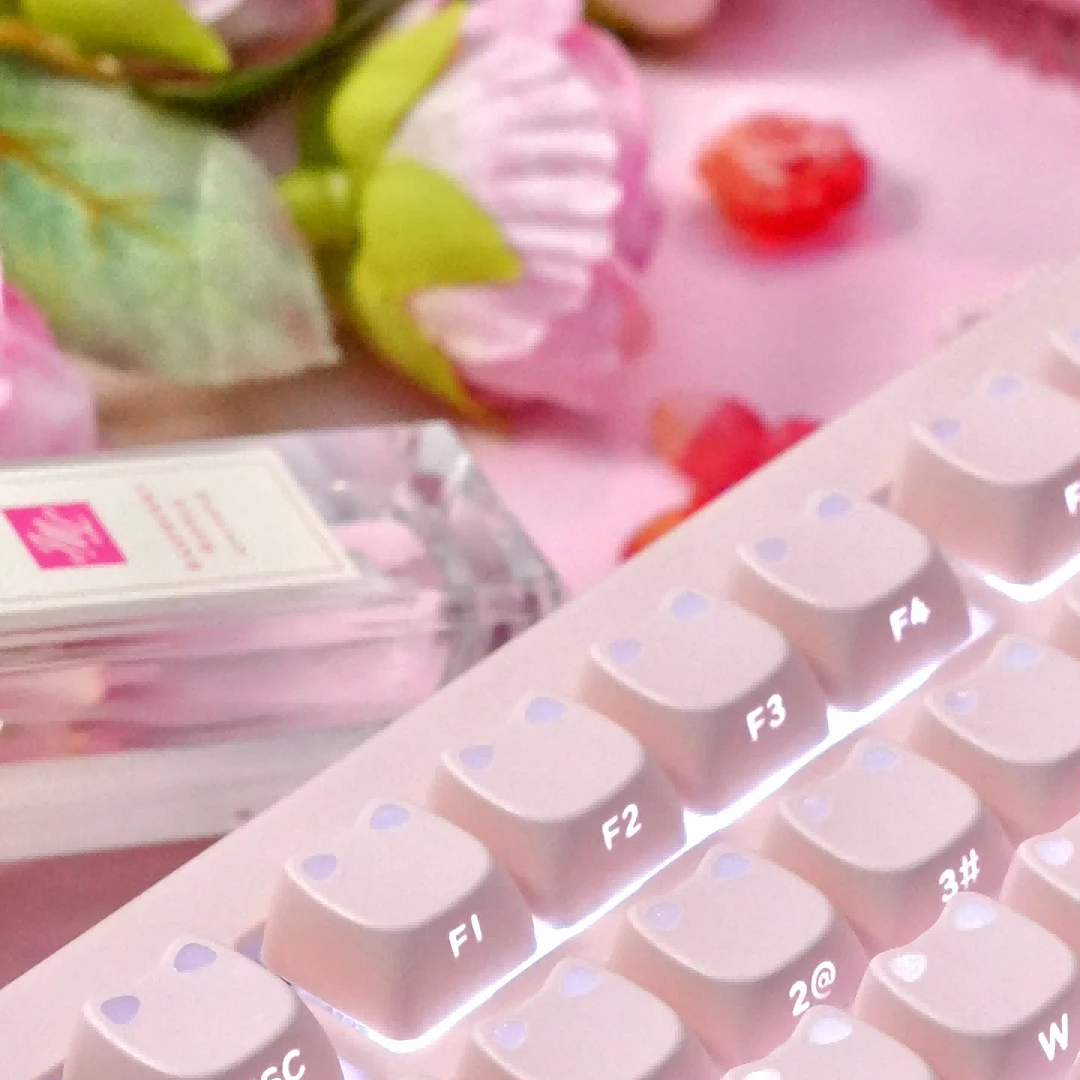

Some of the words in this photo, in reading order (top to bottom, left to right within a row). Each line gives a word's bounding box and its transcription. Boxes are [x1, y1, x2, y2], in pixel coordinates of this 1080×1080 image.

[889, 596, 931, 642] F4
[746, 693, 787, 741] F3
[601, 803, 642, 851] F2
[938, 848, 981, 902] 3#
[448, 913, 483, 958] F1
[788, 960, 837, 1016] 2@
[1038, 1013, 1069, 1062] W
